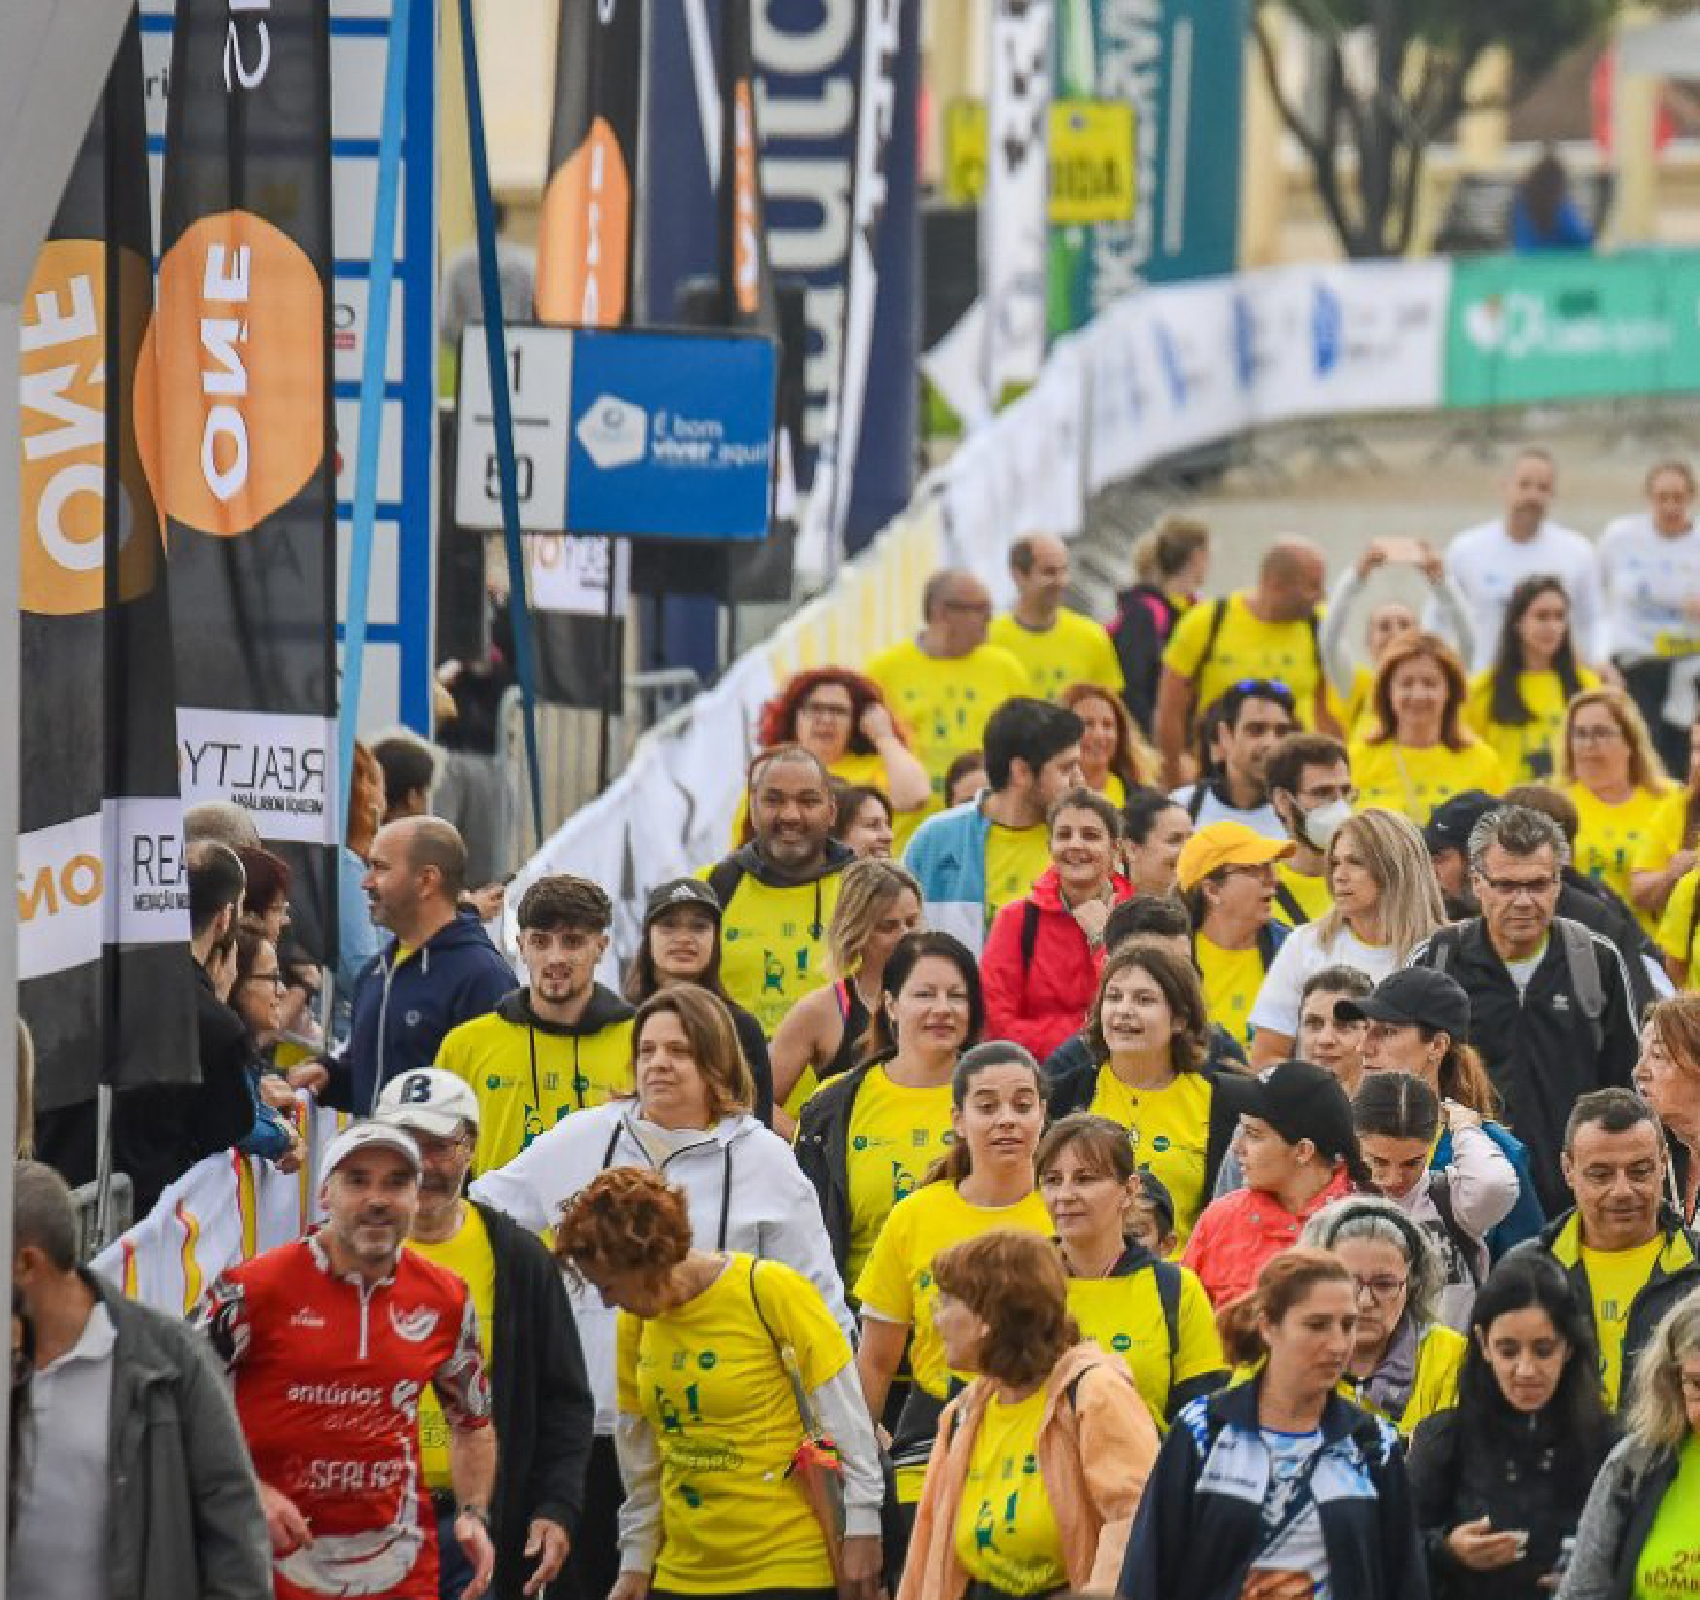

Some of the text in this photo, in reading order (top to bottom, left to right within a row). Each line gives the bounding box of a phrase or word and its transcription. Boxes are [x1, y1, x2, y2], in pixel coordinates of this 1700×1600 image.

[510, 346, 522, 393] 1
[673, 413, 724, 437] bom
[652, 439, 712, 462] viver
